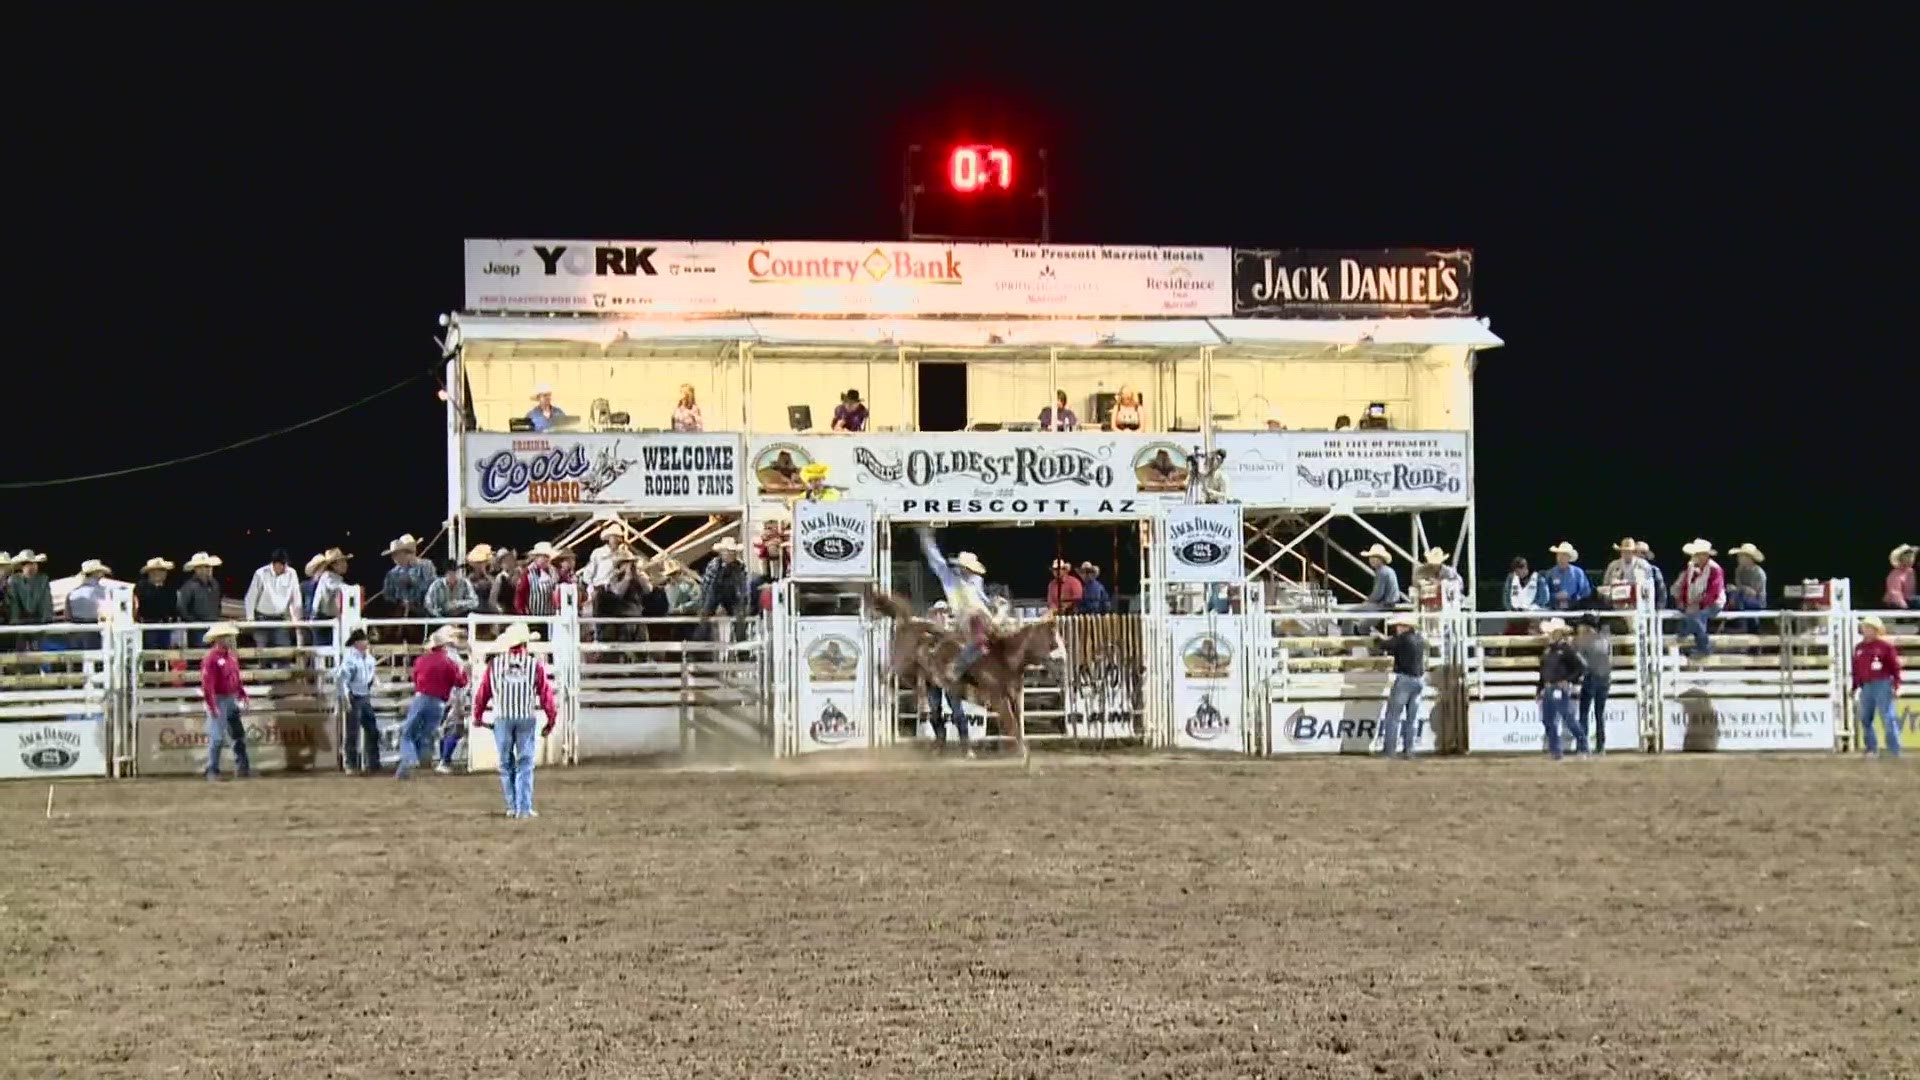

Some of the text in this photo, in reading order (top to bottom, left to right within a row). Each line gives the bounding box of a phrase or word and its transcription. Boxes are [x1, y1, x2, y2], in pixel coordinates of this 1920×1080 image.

[533, 246, 658, 276] YORK
[748, 249, 963, 282] Country Bank
[1012, 248, 1205, 261] The Prescott Marriott Hotels
[483, 261, 520, 276] Jeep
[1251, 258, 1460, 302] JACK DANIEL'S
[1147, 277, 1215, 290] Residence
[642, 446, 733, 471] WELCOME
[907, 449, 1016, 487] OLDEST
[1015, 446, 1114, 488] RODEO
[476, 442, 590, 504] Coors
[1328, 467, 1391, 491] OLDEST
[1393, 463, 1460, 493] RODEO
[528, 480, 580, 504] RODEO
[644, 475, 734, 496] RODEO FANS
[903, 500, 1135, 515] PRESCOTT, AZ
[1294, 715, 1430, 739] BARRT
